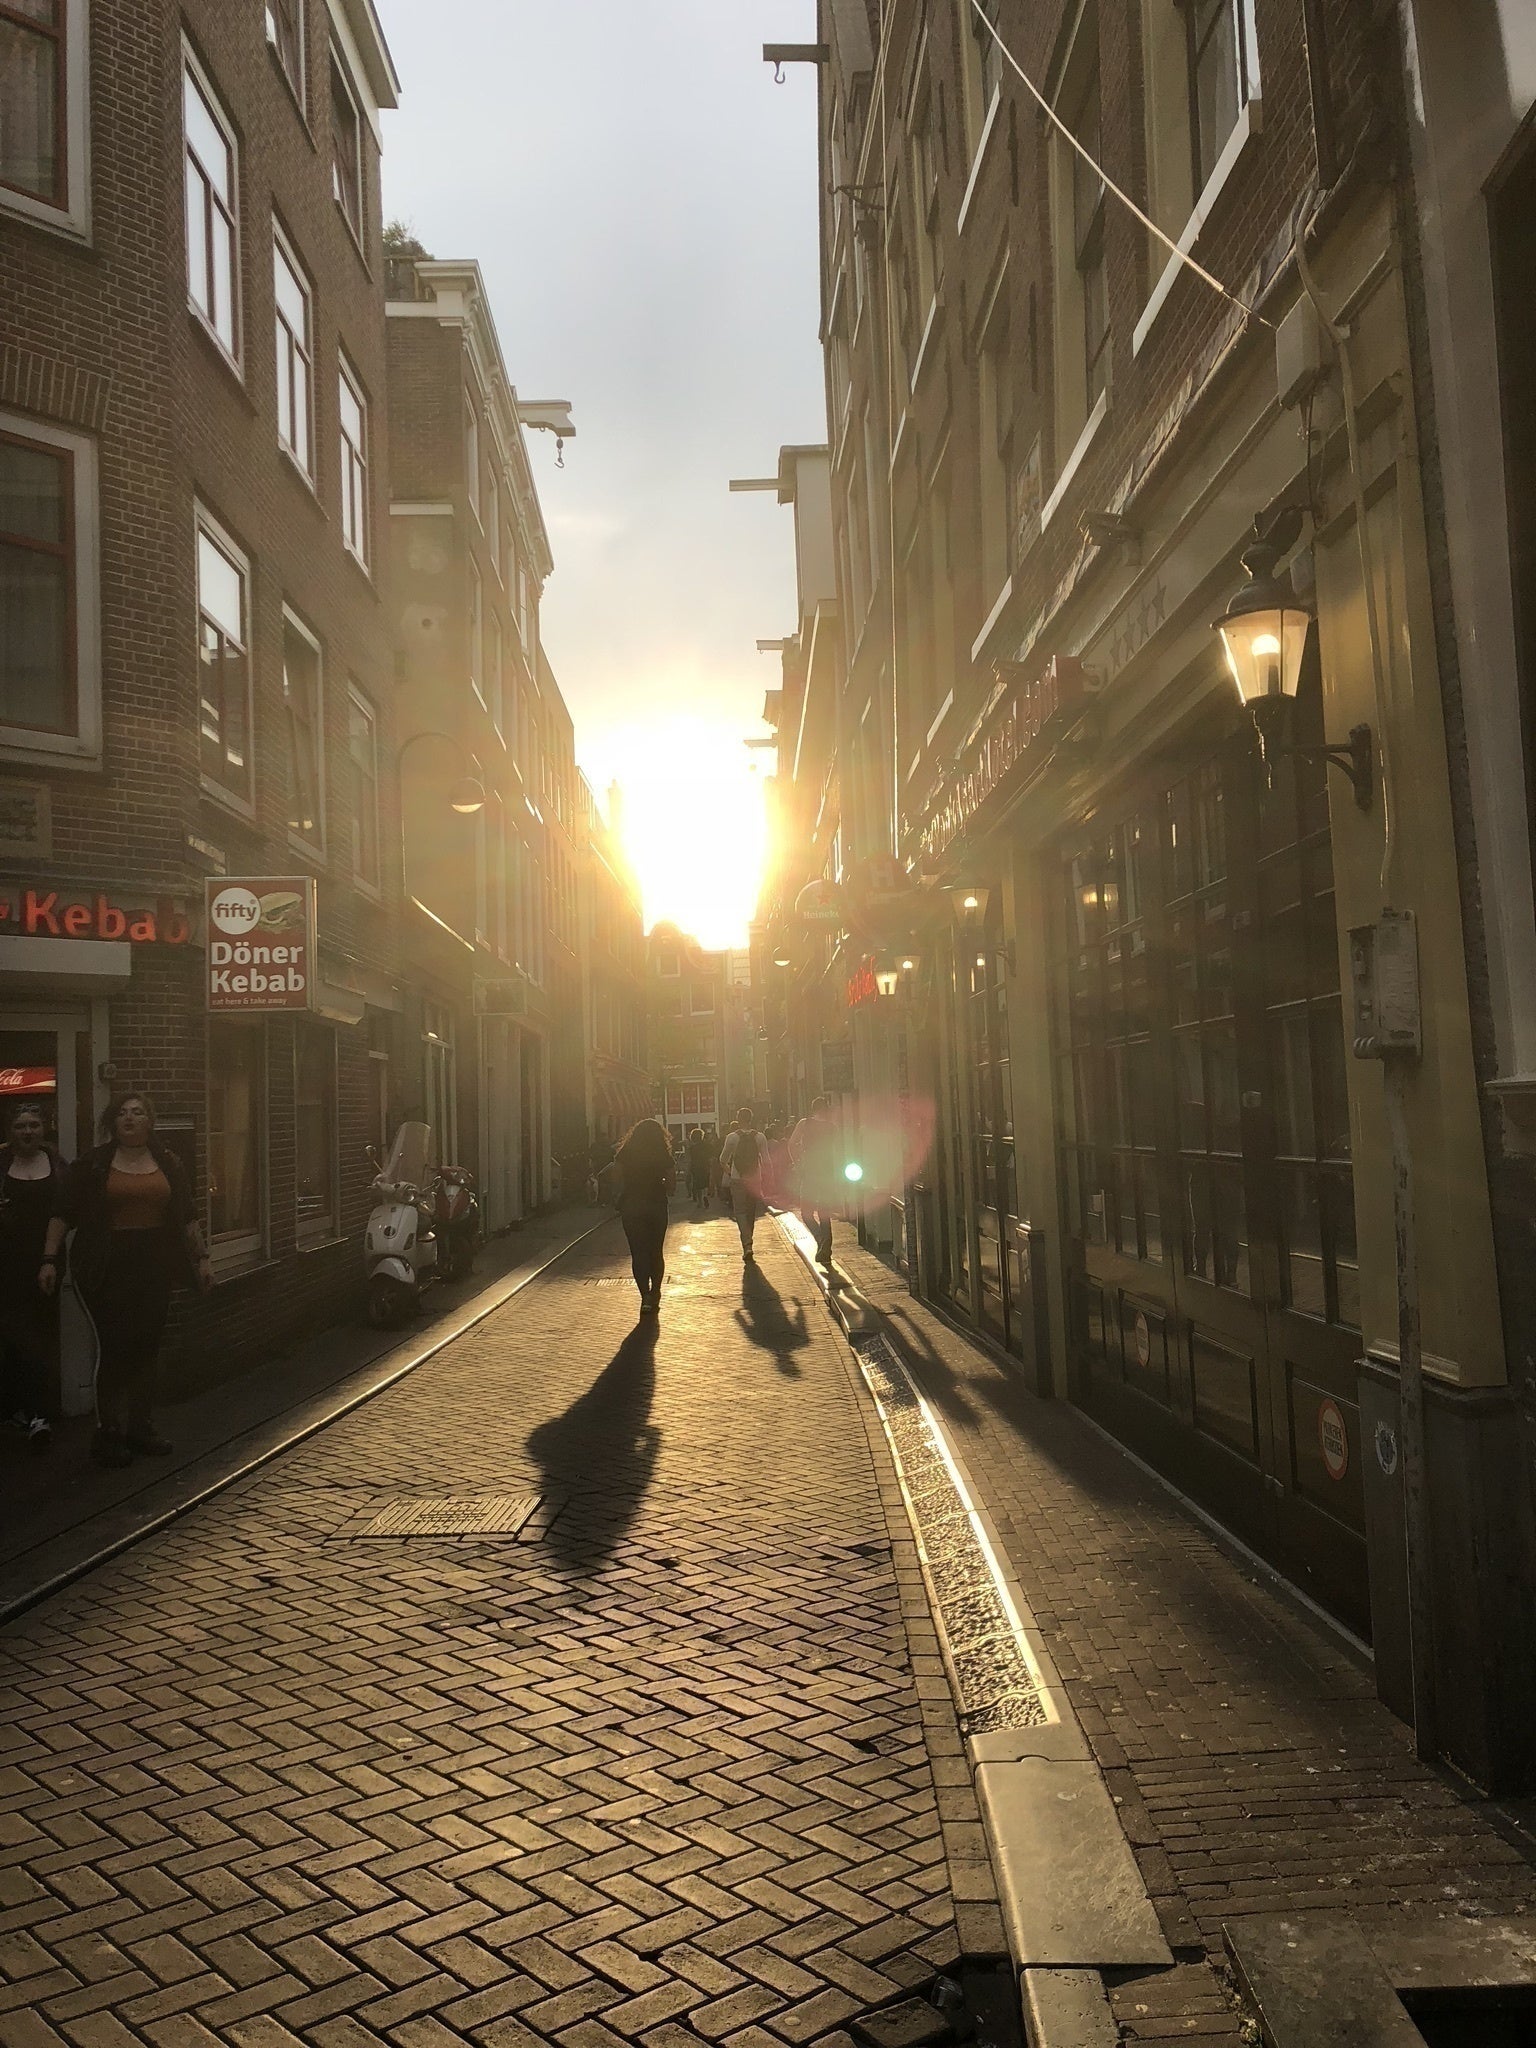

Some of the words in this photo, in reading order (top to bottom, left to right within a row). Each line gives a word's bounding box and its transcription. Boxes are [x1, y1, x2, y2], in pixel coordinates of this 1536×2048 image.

[25, 889, 189, 944] Kebab
[214, 903, 257, 921] fifty
[211, 942, 303, 965] Döner
[211, 968, 305, 993] Kebab
[225, 997, 242, 1005] here
[243, 997, 249, 1005] &
[250, 997, 266, 1005] take
[267, 998, 287, 1006] away
